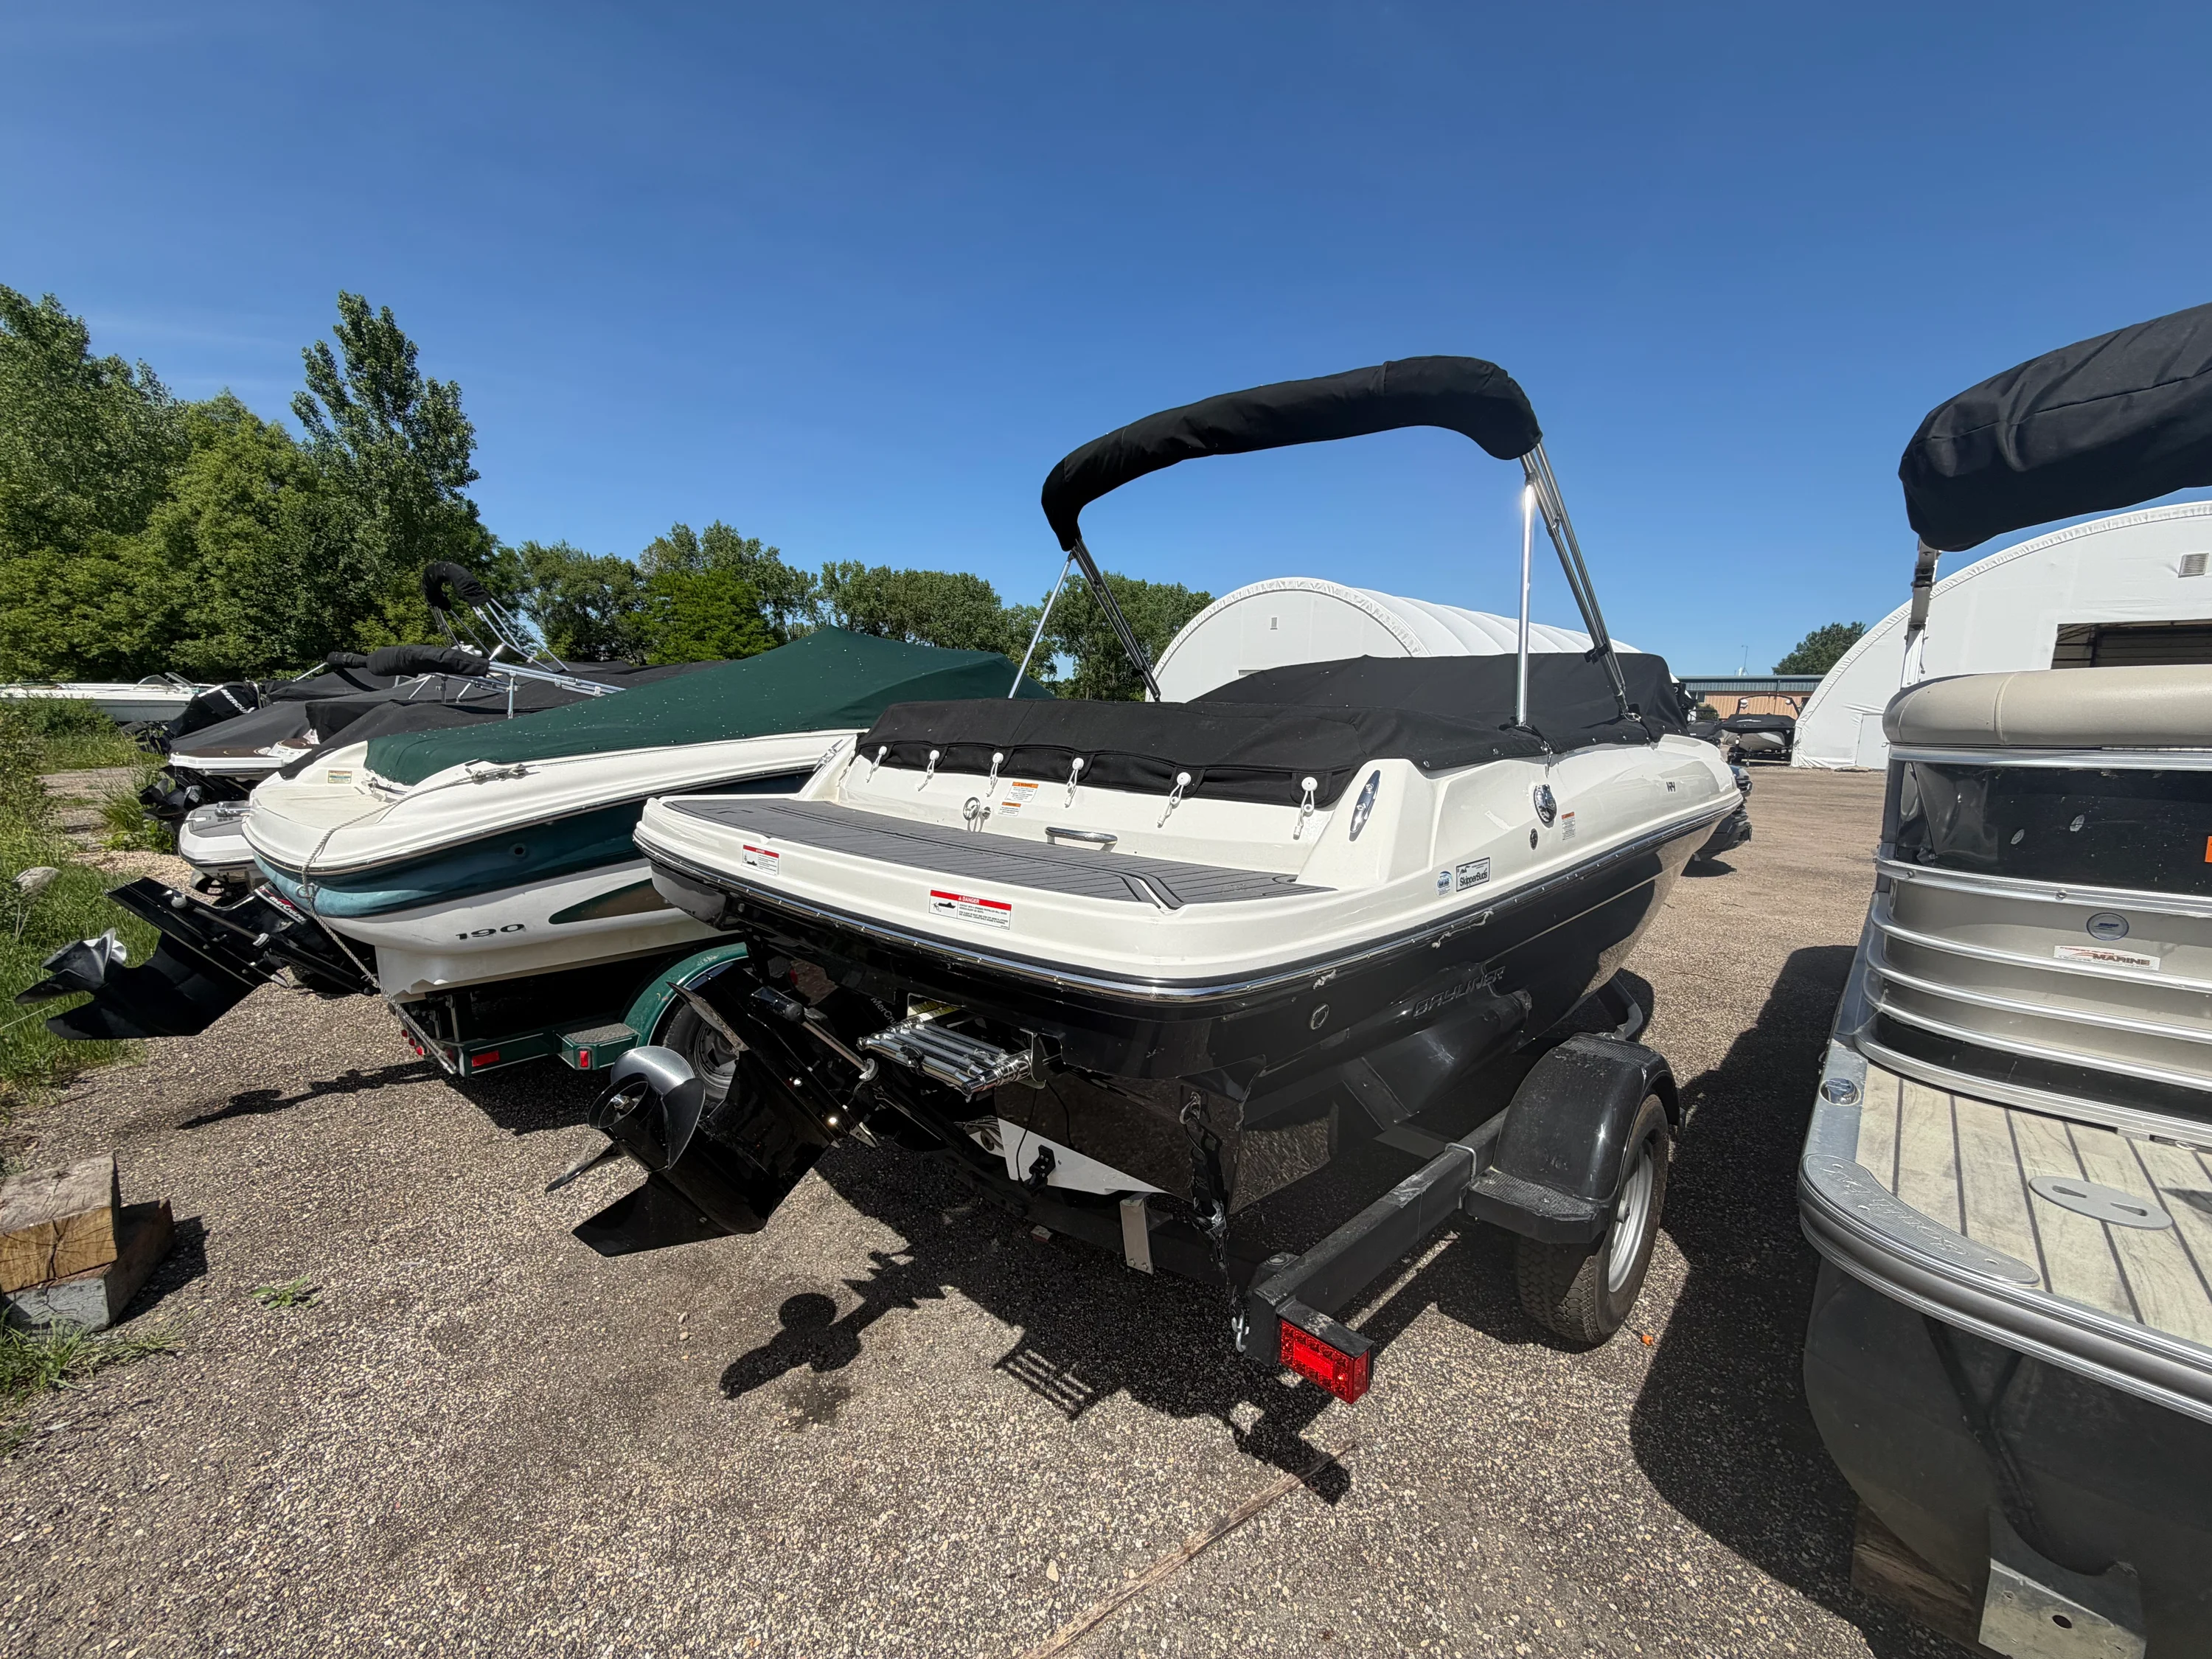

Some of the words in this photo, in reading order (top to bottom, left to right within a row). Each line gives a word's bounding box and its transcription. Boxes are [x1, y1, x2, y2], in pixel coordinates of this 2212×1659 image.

[220, 689, 248, 714] MERCU
[961, 896, 980, 904] DANGER
[455, 923, 526, 940] 190
[2093, 953, 2151, 967] MARINE
[870, 997, 898, 1025] MerCru
